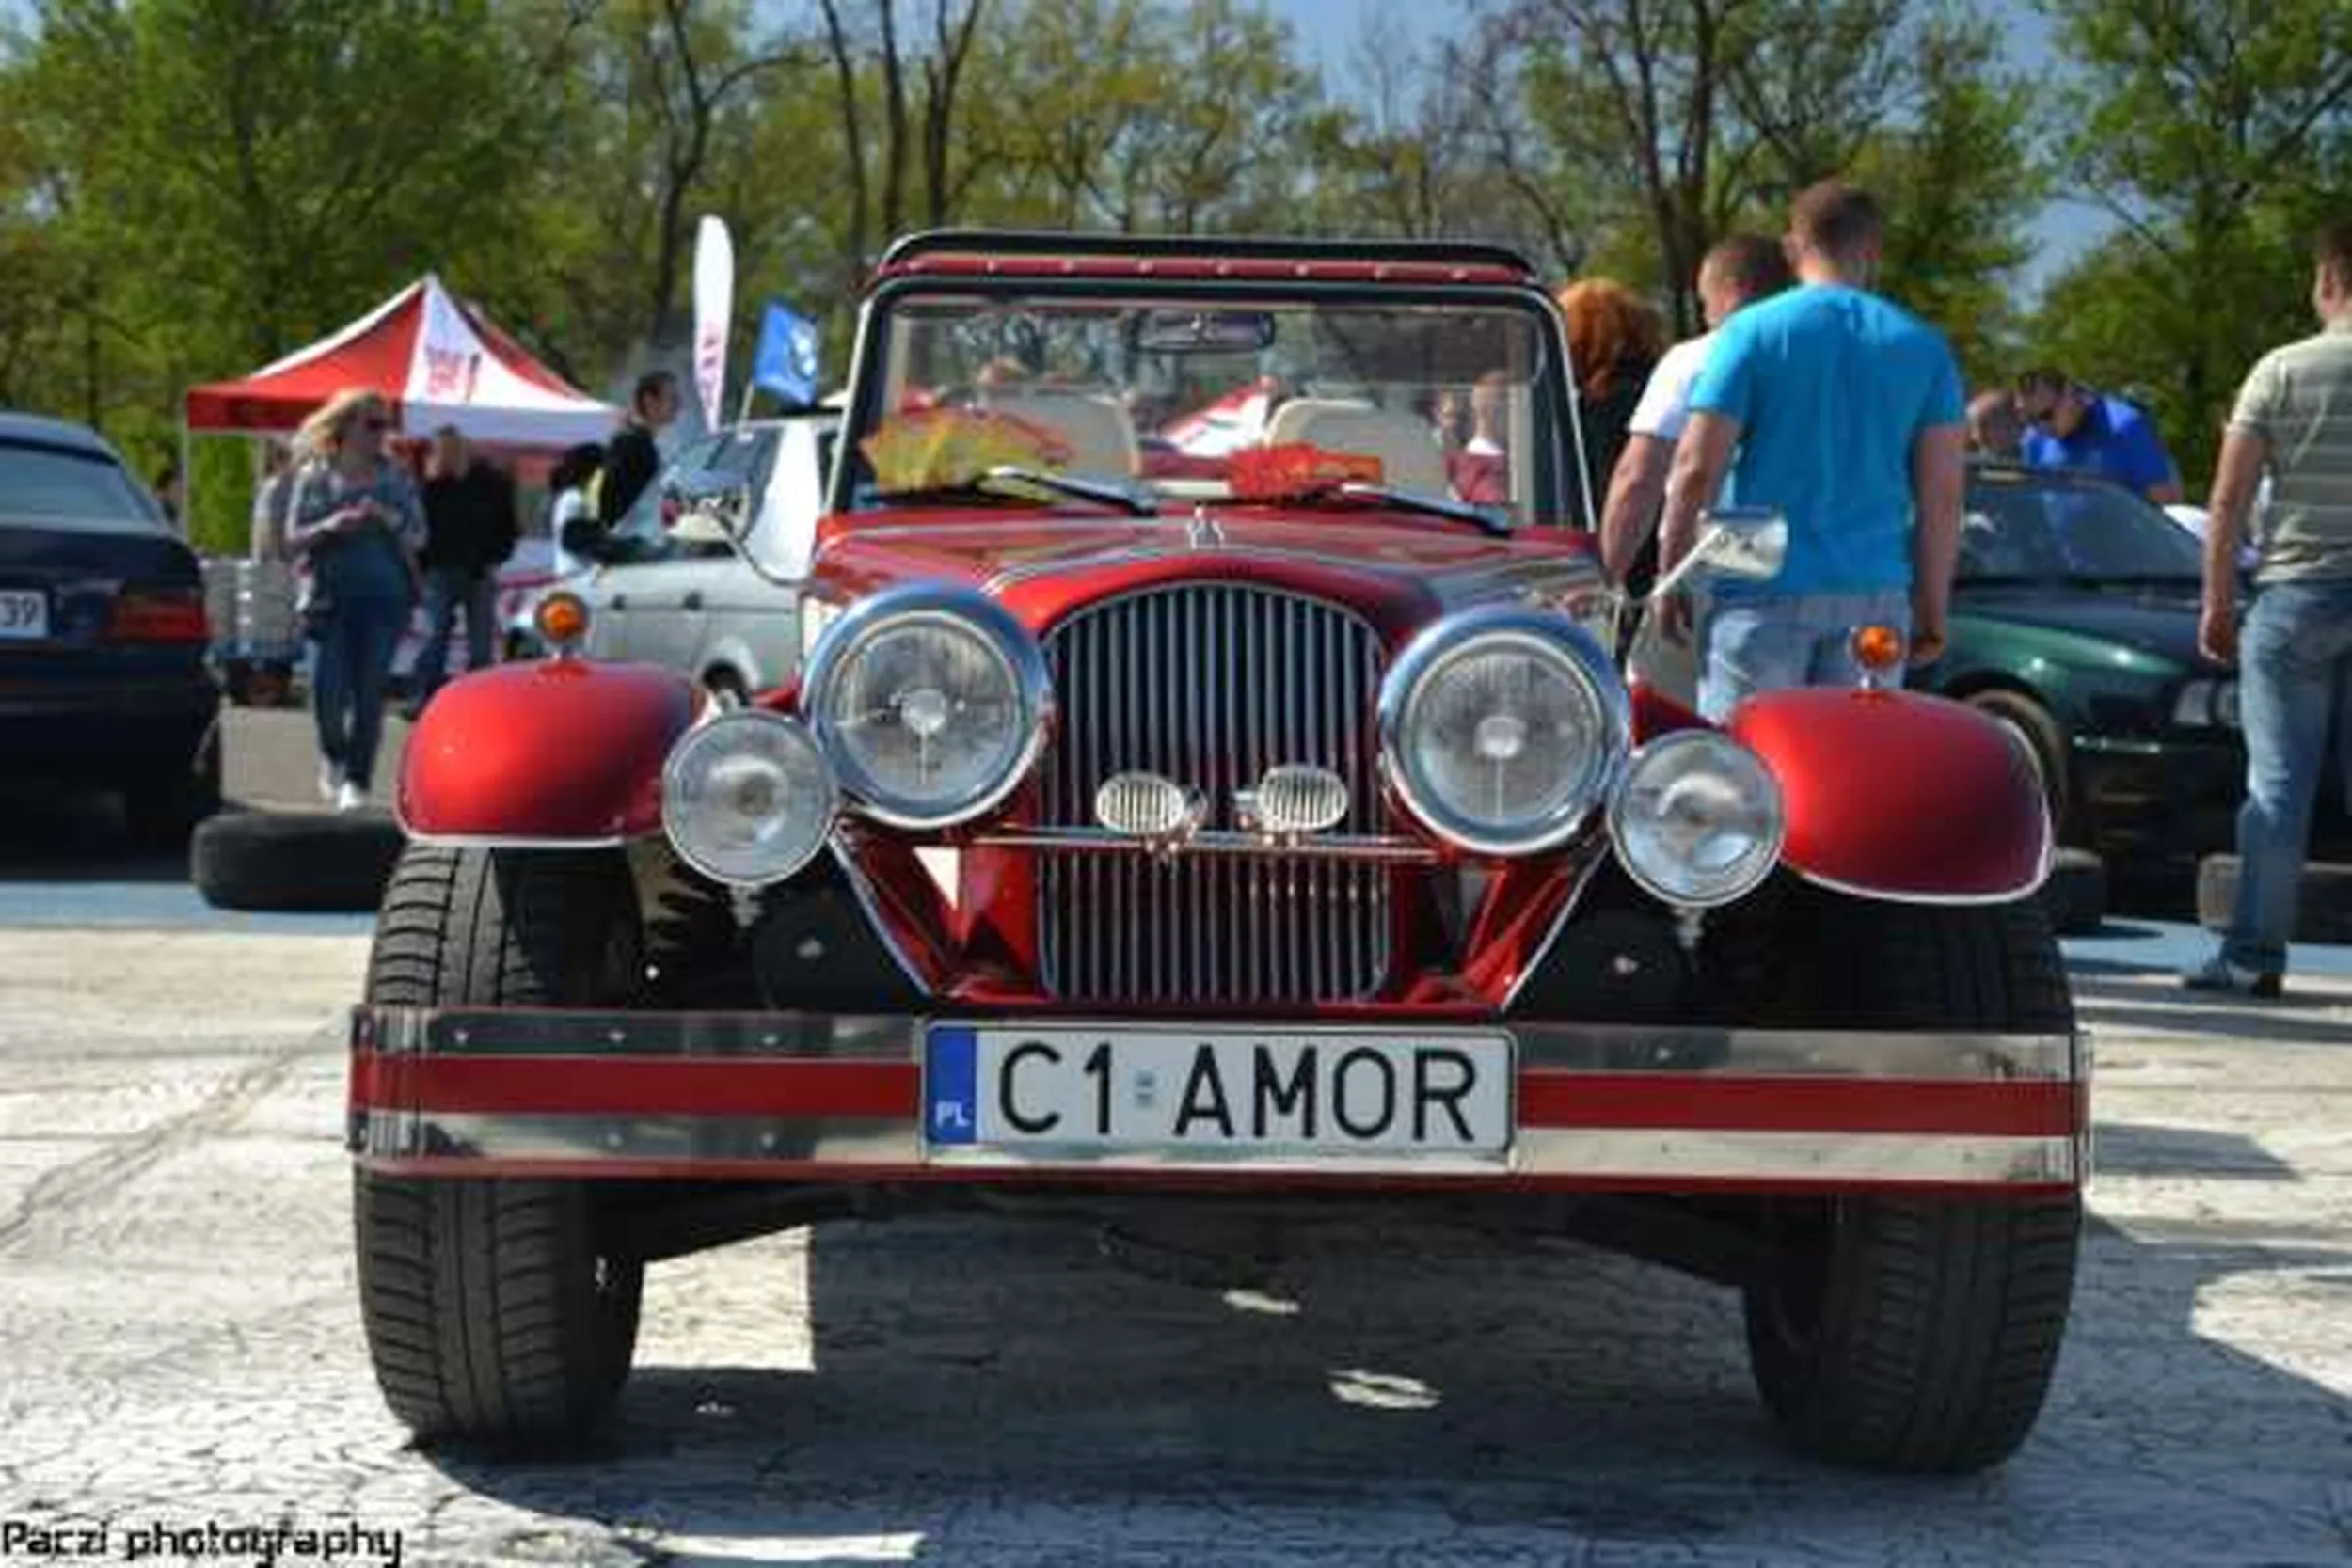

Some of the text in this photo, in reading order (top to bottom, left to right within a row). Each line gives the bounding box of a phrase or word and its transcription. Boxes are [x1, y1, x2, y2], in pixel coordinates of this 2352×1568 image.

[936, 1100, 971, 1128] PL
[999, 1042, 1475, 1142] C1 AMOR
